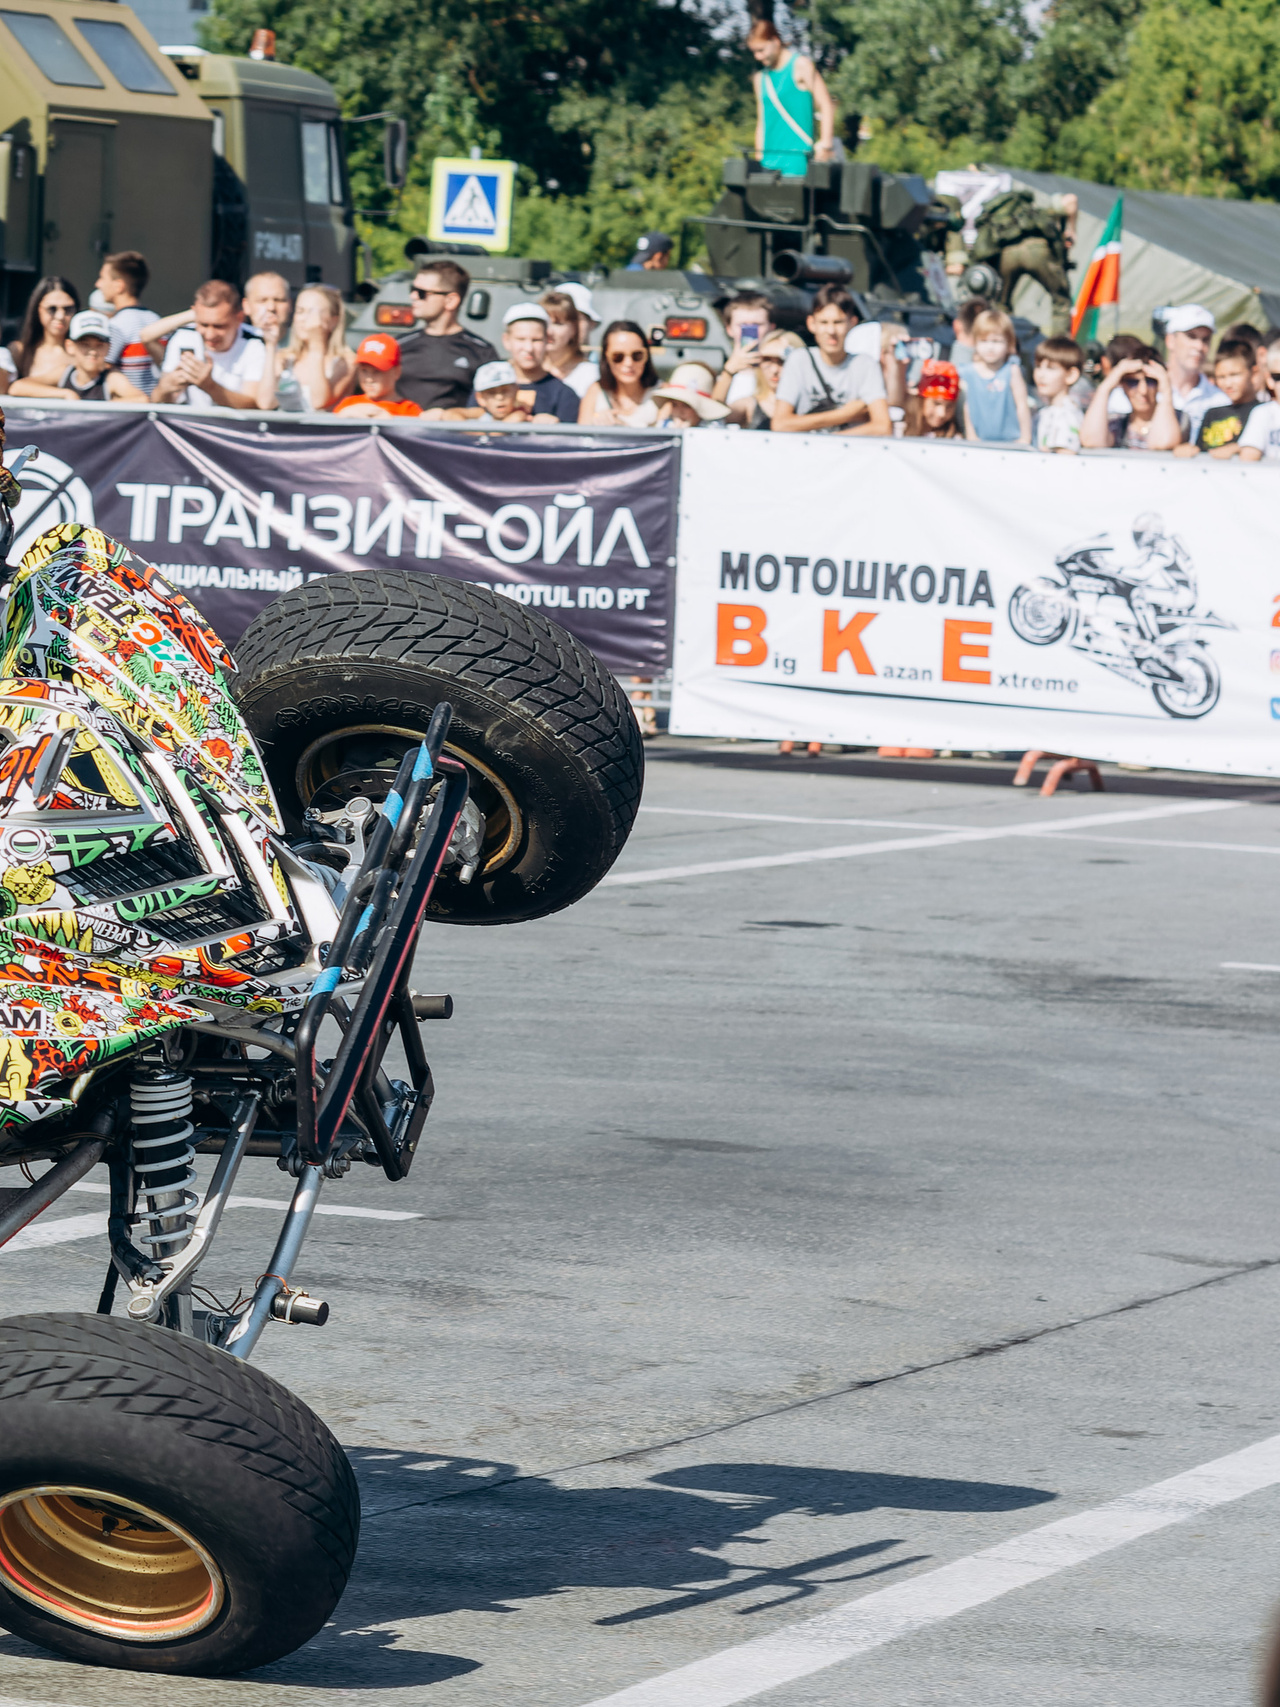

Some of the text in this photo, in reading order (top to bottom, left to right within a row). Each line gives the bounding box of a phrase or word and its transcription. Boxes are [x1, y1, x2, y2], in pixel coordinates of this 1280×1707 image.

[115, 482, 652, 568] ТРАНЗИТ-ОЙЛ
[151, 561, 302, 592] ИЦИАЛЬНЫЙ
[577, 586, 614, 609] ПО
[617, 588, 651, 612] РТ
[720, 551, 997, 609] МОТОШКОЛА
